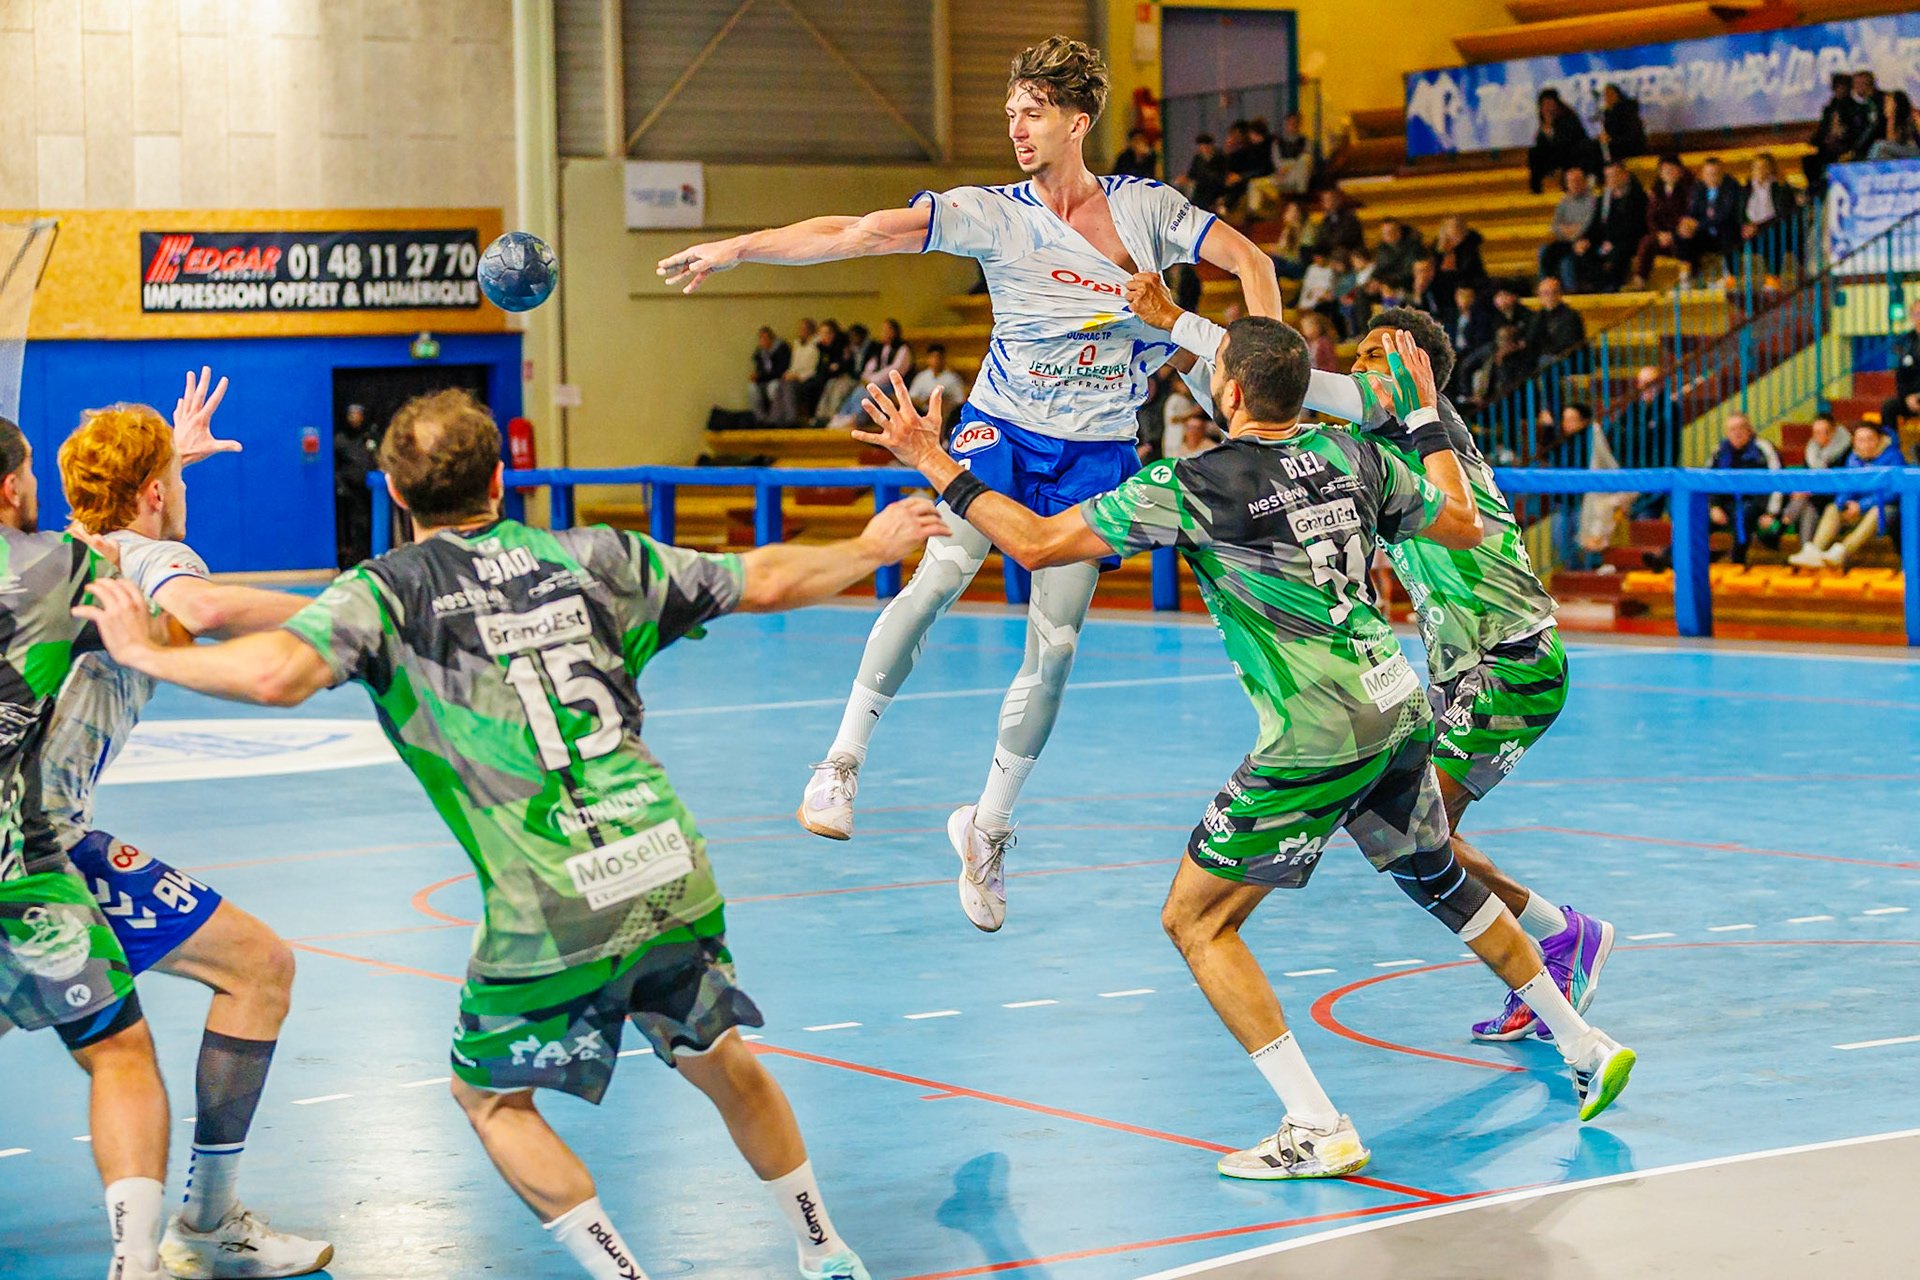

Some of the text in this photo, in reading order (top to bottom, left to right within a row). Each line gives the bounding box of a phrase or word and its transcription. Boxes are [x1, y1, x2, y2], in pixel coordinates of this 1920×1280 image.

[183, 242, 477, 279] EDGAR 01 48 11 27 70
[143, 282, 268, 309] IMPRESSION
[269, 281, 340, 308] OFFSET
[342, 281, 361, 307] &
[1029, 360, 1064, 376] JEAN
[956, 427, 995, 448] cora
[1279, 450, 1325, 480] BLEL
[504, 640, 624, 771] 15
[1437, 732, 1469, 760] Kempa
[575, 831, 683, 886] Moselle
[1197, 839, 1238, 867] Kempa
[152, 870, 209, 914] 94
[795, 1191, 828, 1246] Kempa
[587, 1221, 641, 1280] Kempa
